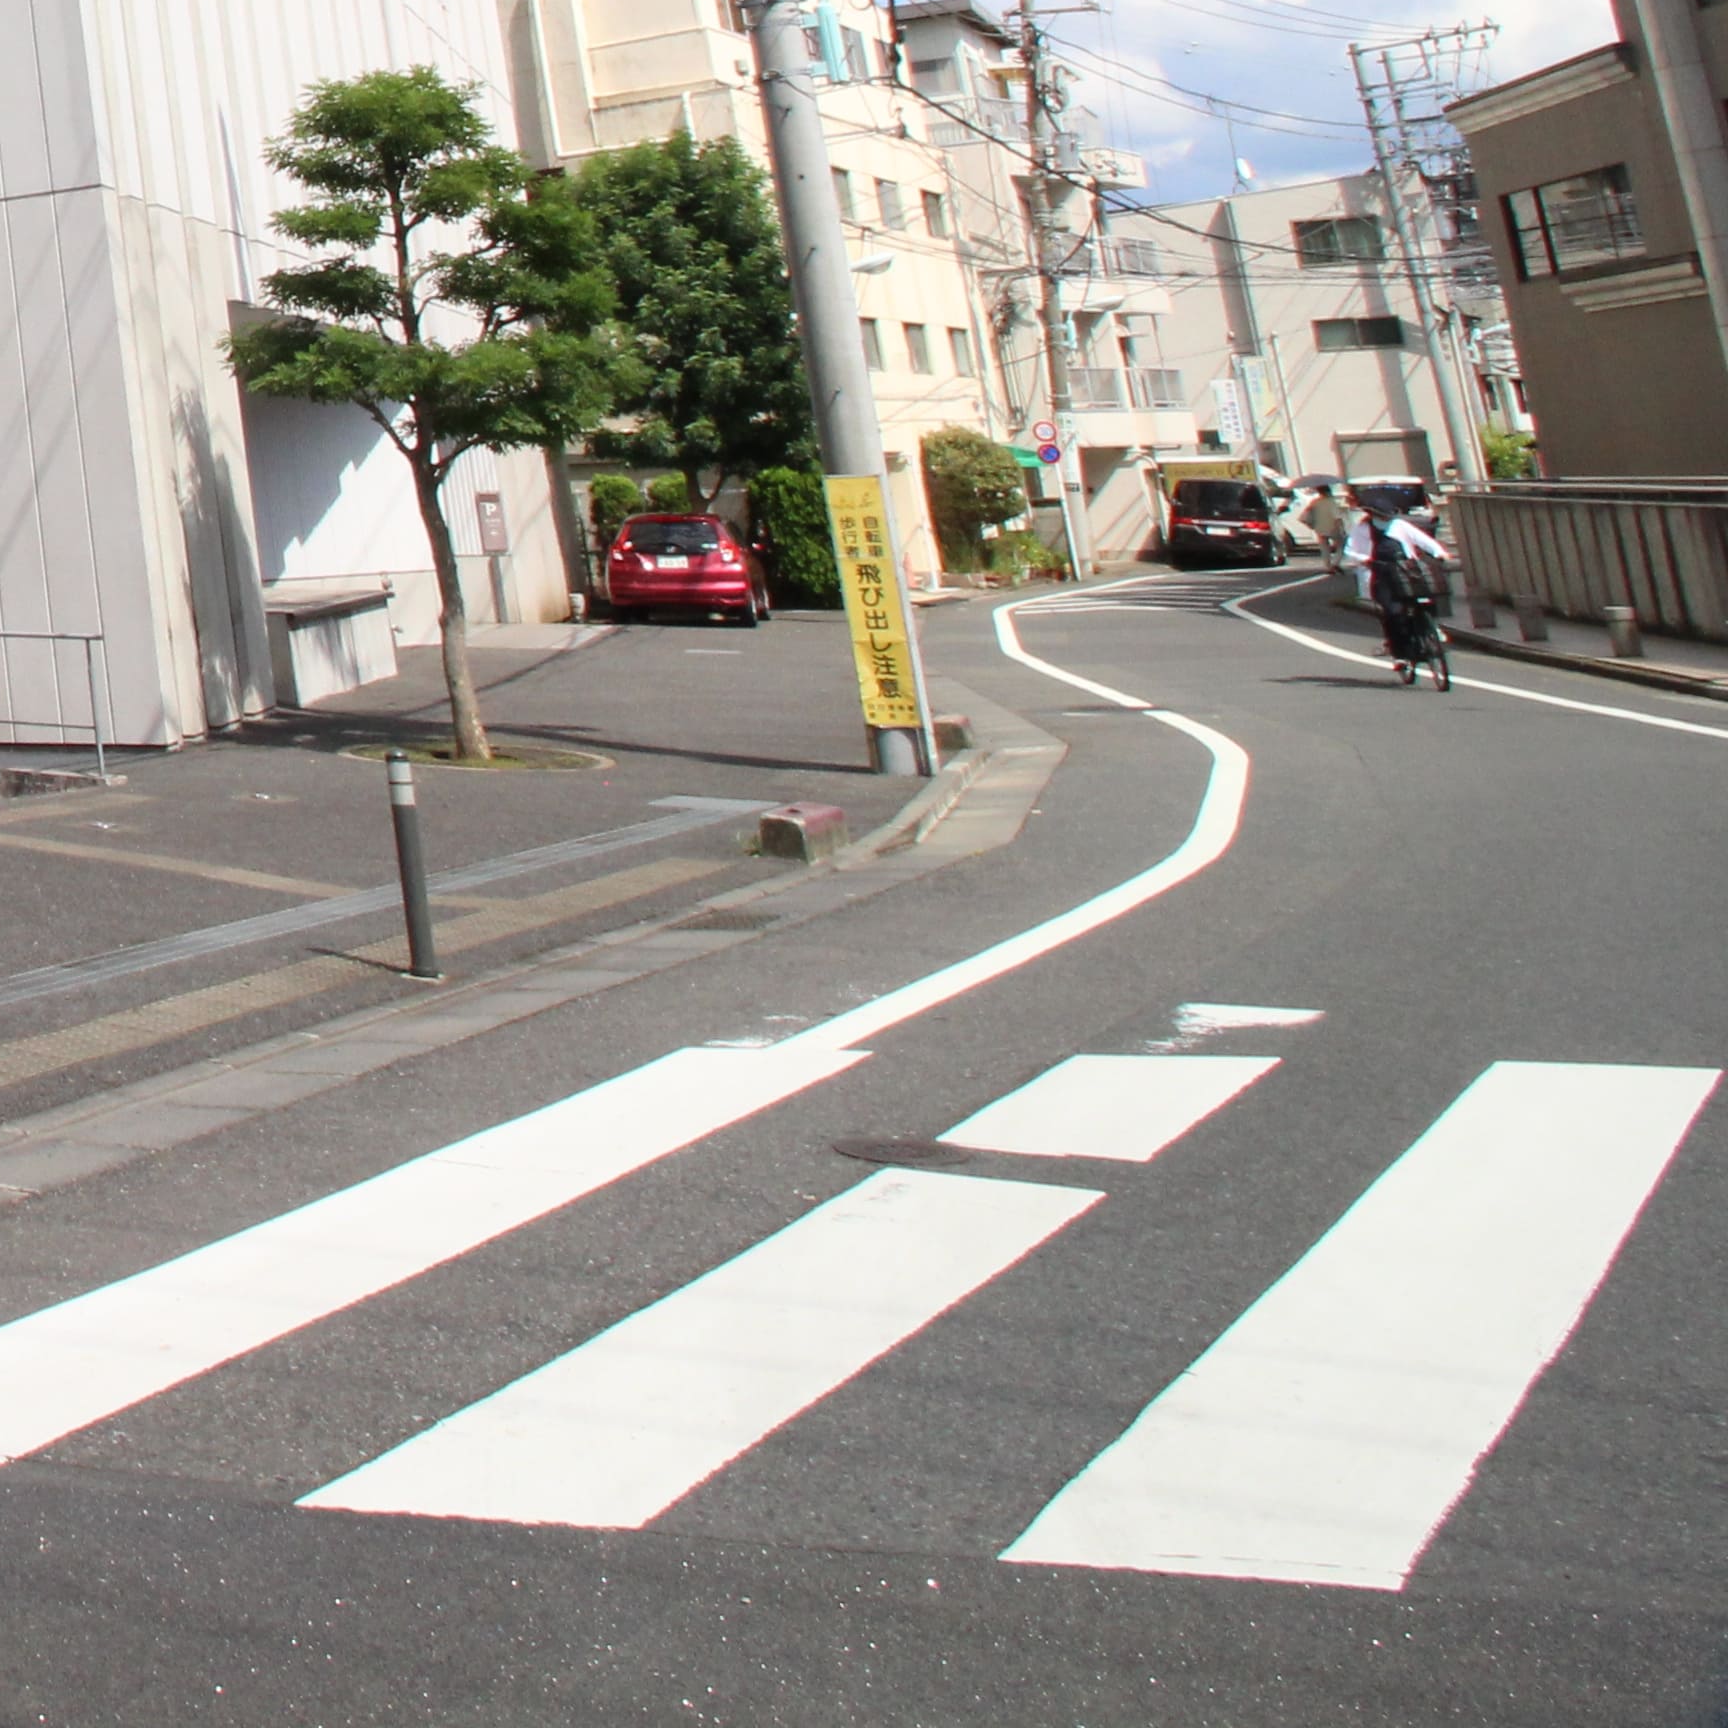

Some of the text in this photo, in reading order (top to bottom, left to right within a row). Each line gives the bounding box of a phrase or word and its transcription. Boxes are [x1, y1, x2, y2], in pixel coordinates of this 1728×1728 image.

[485, 502, 497, 516] P
[856, 564, 902, 699] 飛び出し注意
